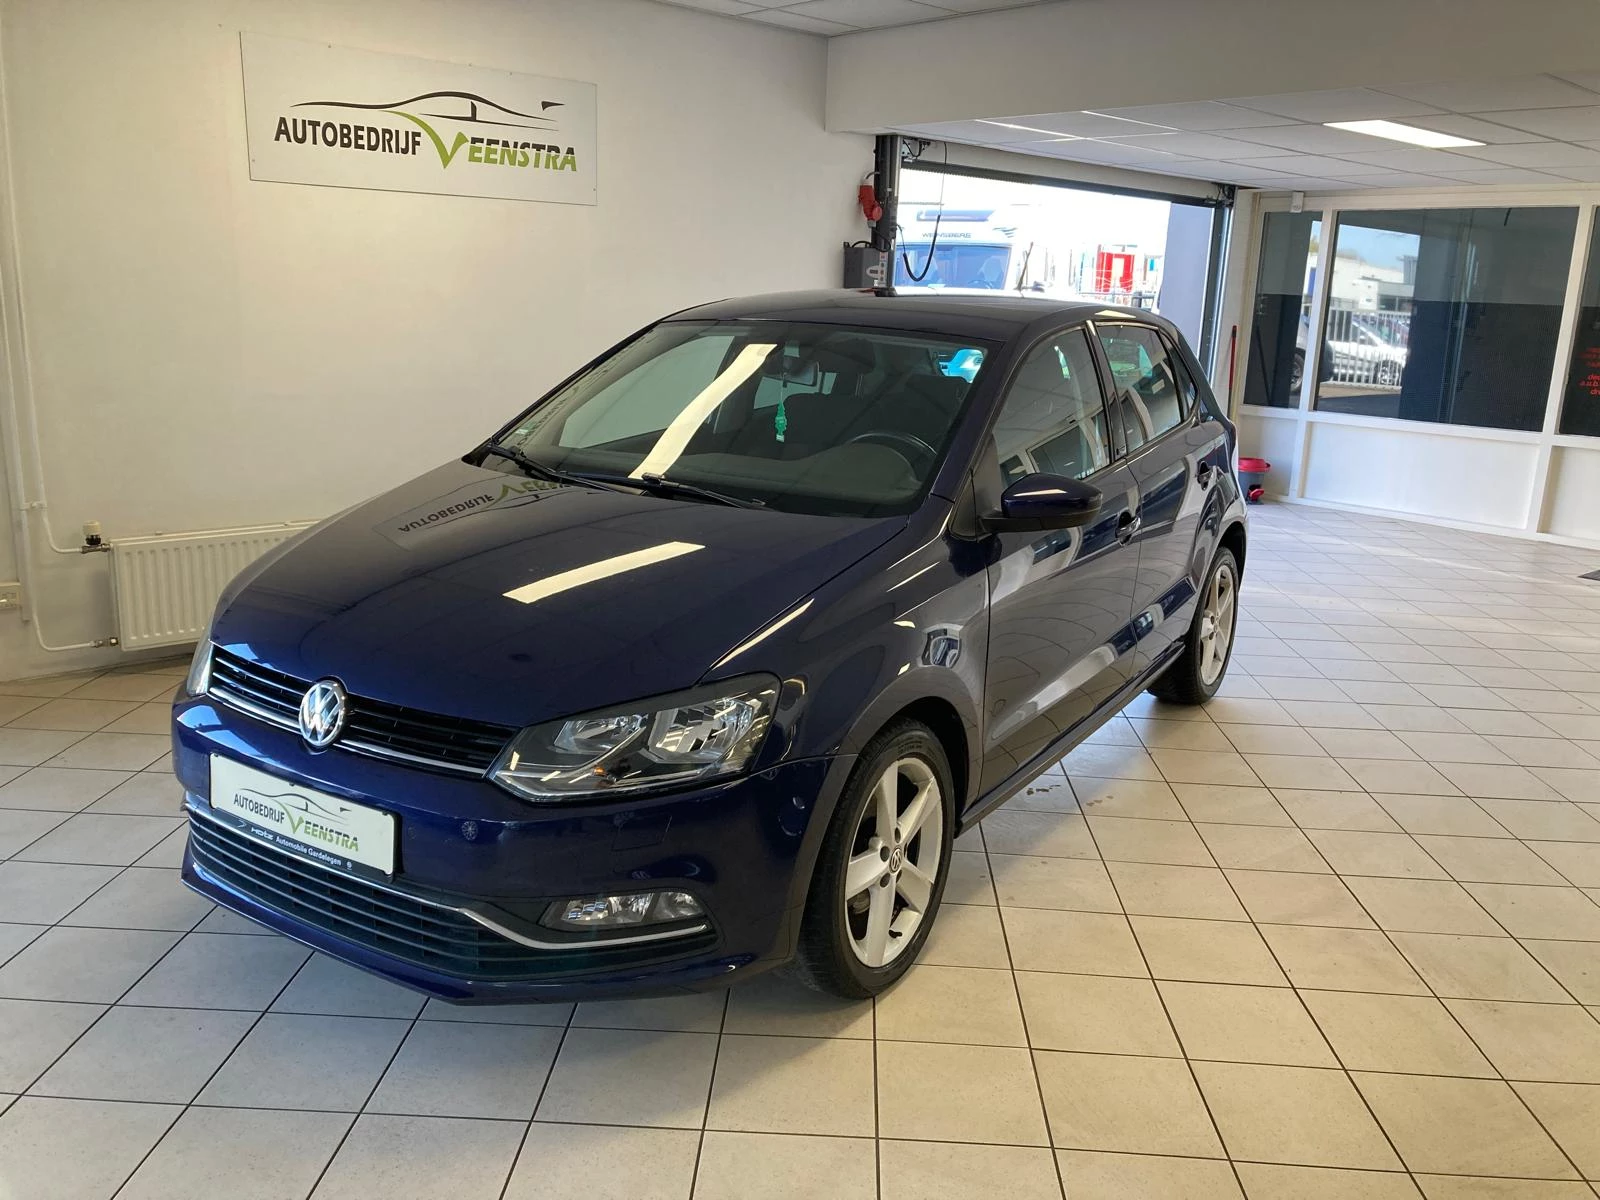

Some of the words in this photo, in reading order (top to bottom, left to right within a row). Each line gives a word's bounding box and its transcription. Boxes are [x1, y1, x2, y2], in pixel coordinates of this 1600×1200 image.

[274, 116, 422, 156] AUTOBEDRIJF
[398, 111, 578, 172] VEENSTRA
[233, 793, 285, 825] AUTOBEDRIJF
[275, 835, 308, 854] Automobile
